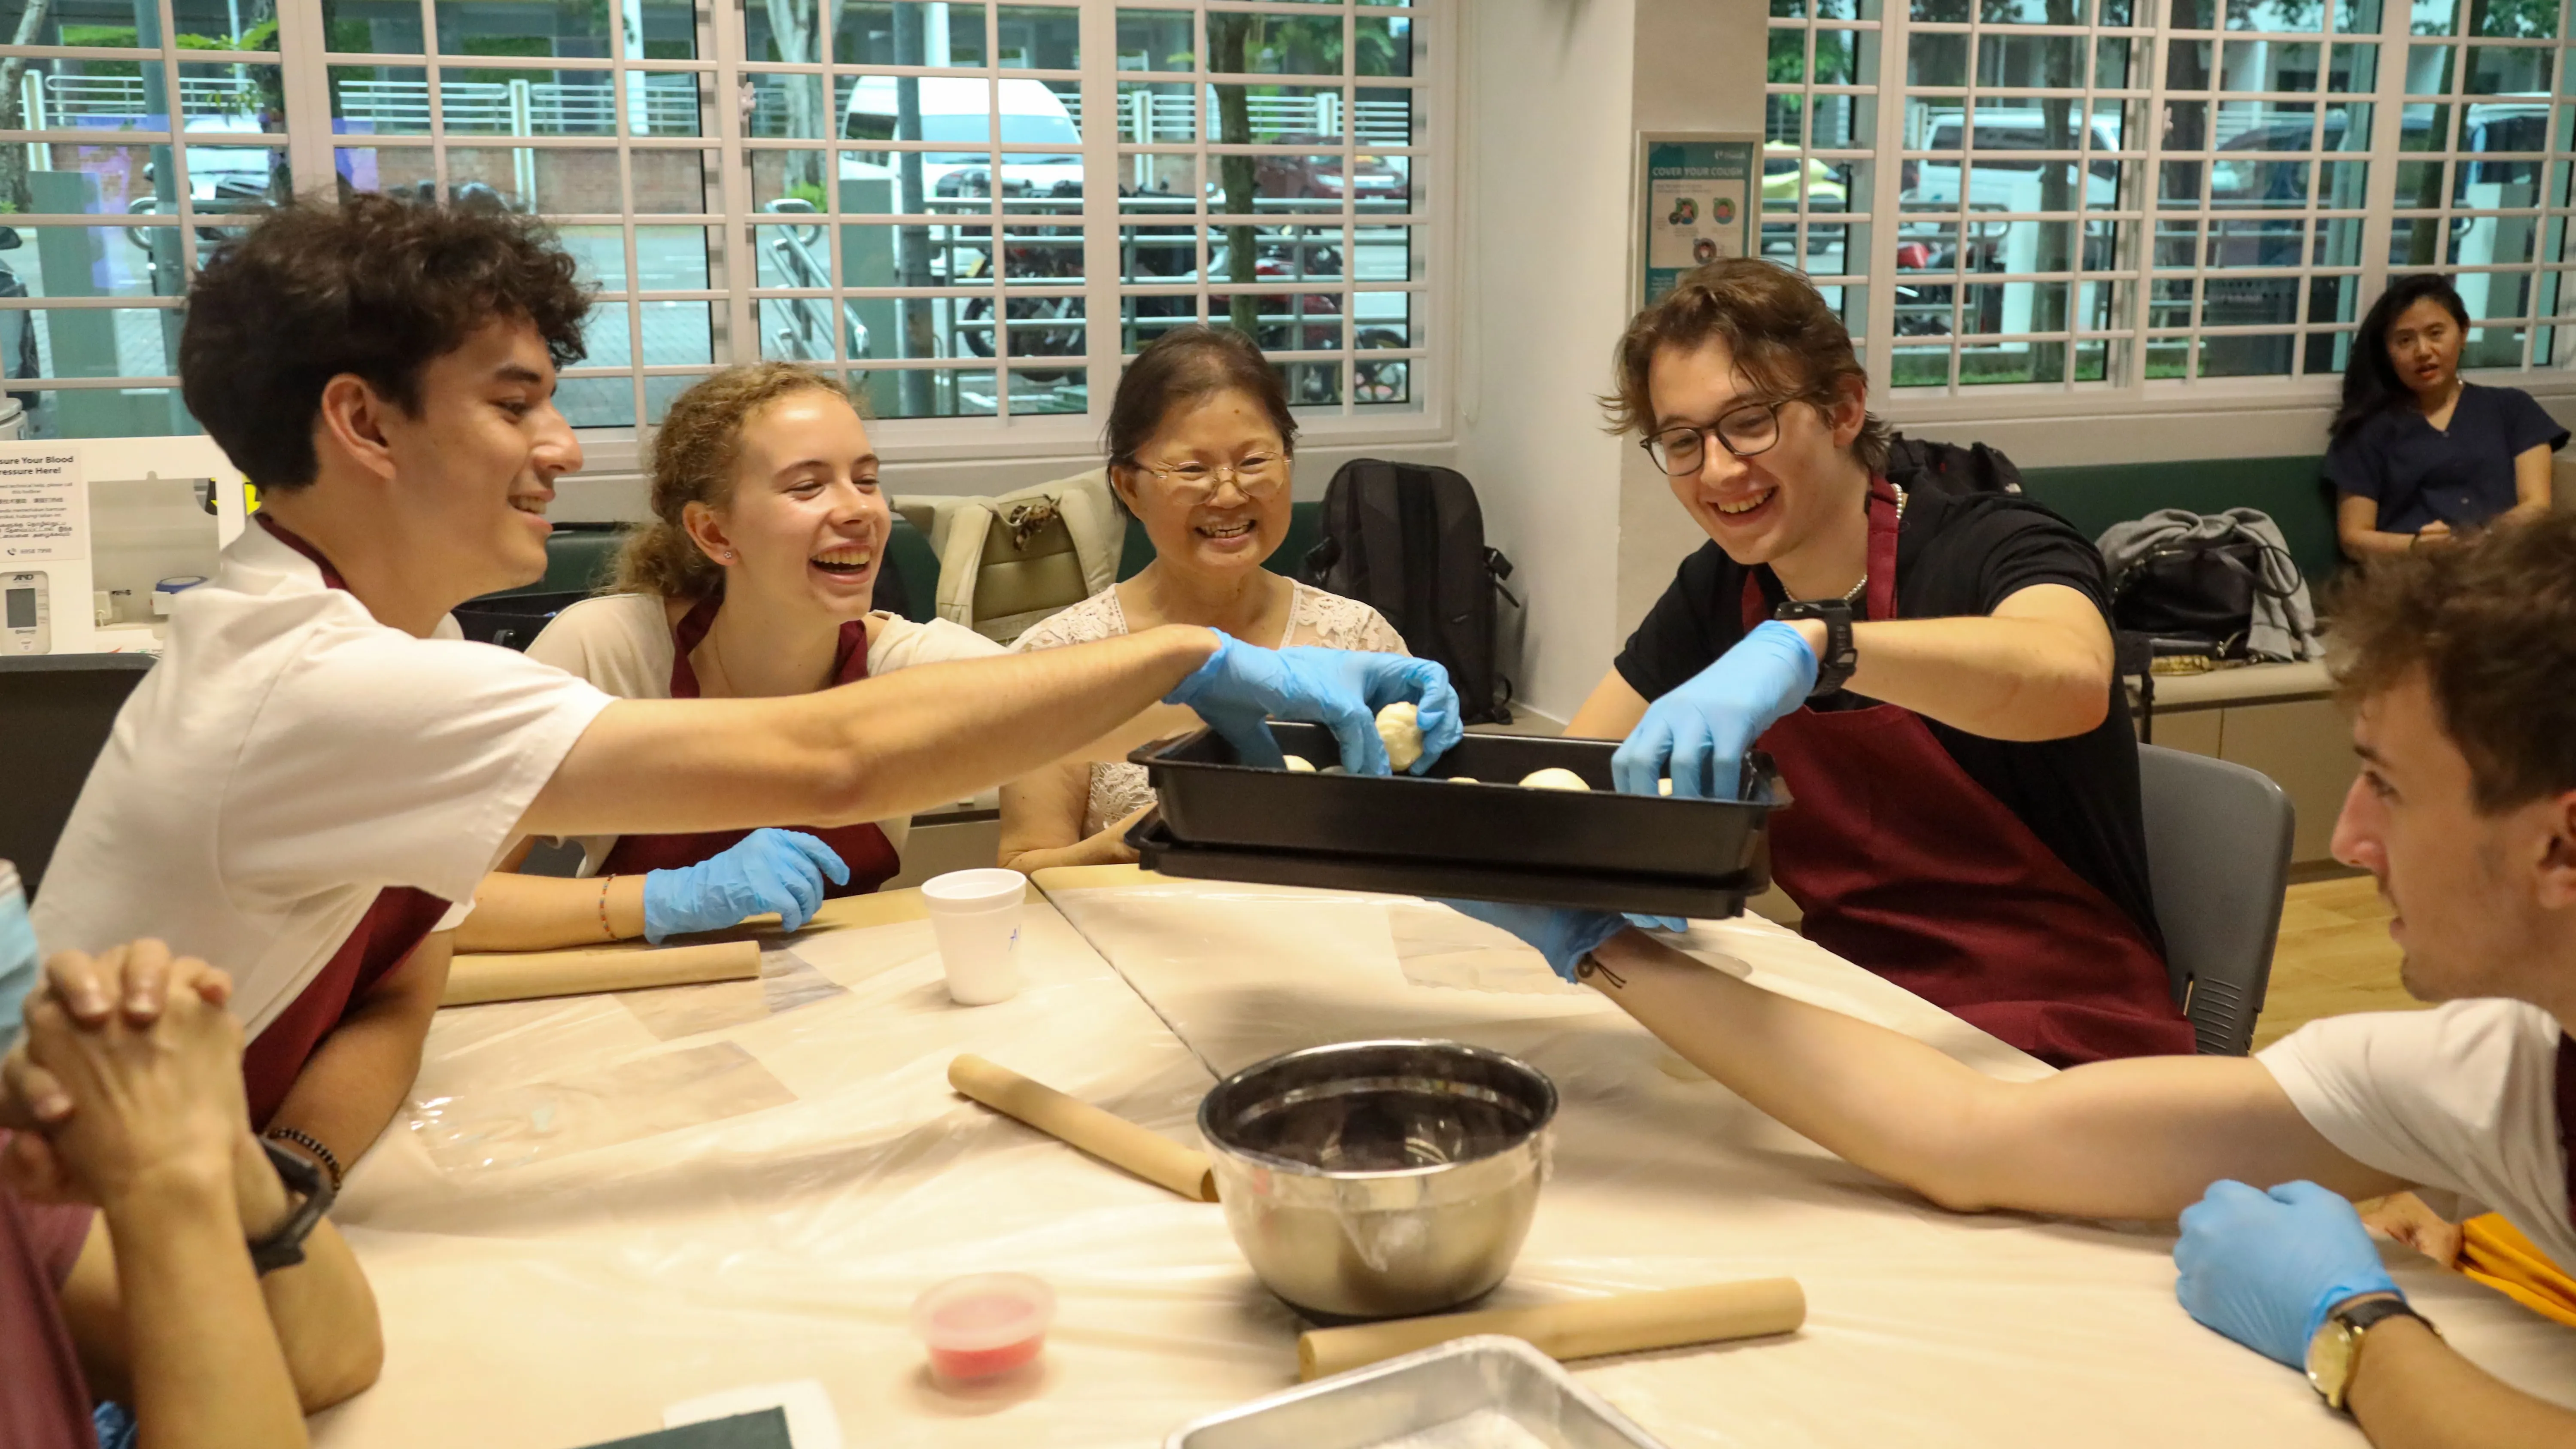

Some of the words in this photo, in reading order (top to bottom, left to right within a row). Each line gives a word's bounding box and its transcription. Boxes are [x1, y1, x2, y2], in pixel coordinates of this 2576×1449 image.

[1653, 167, 1682, 176] COVER
[1684, 167, 1709, 176] YOUR
[1711, 167, 1743, 176] COUGH
